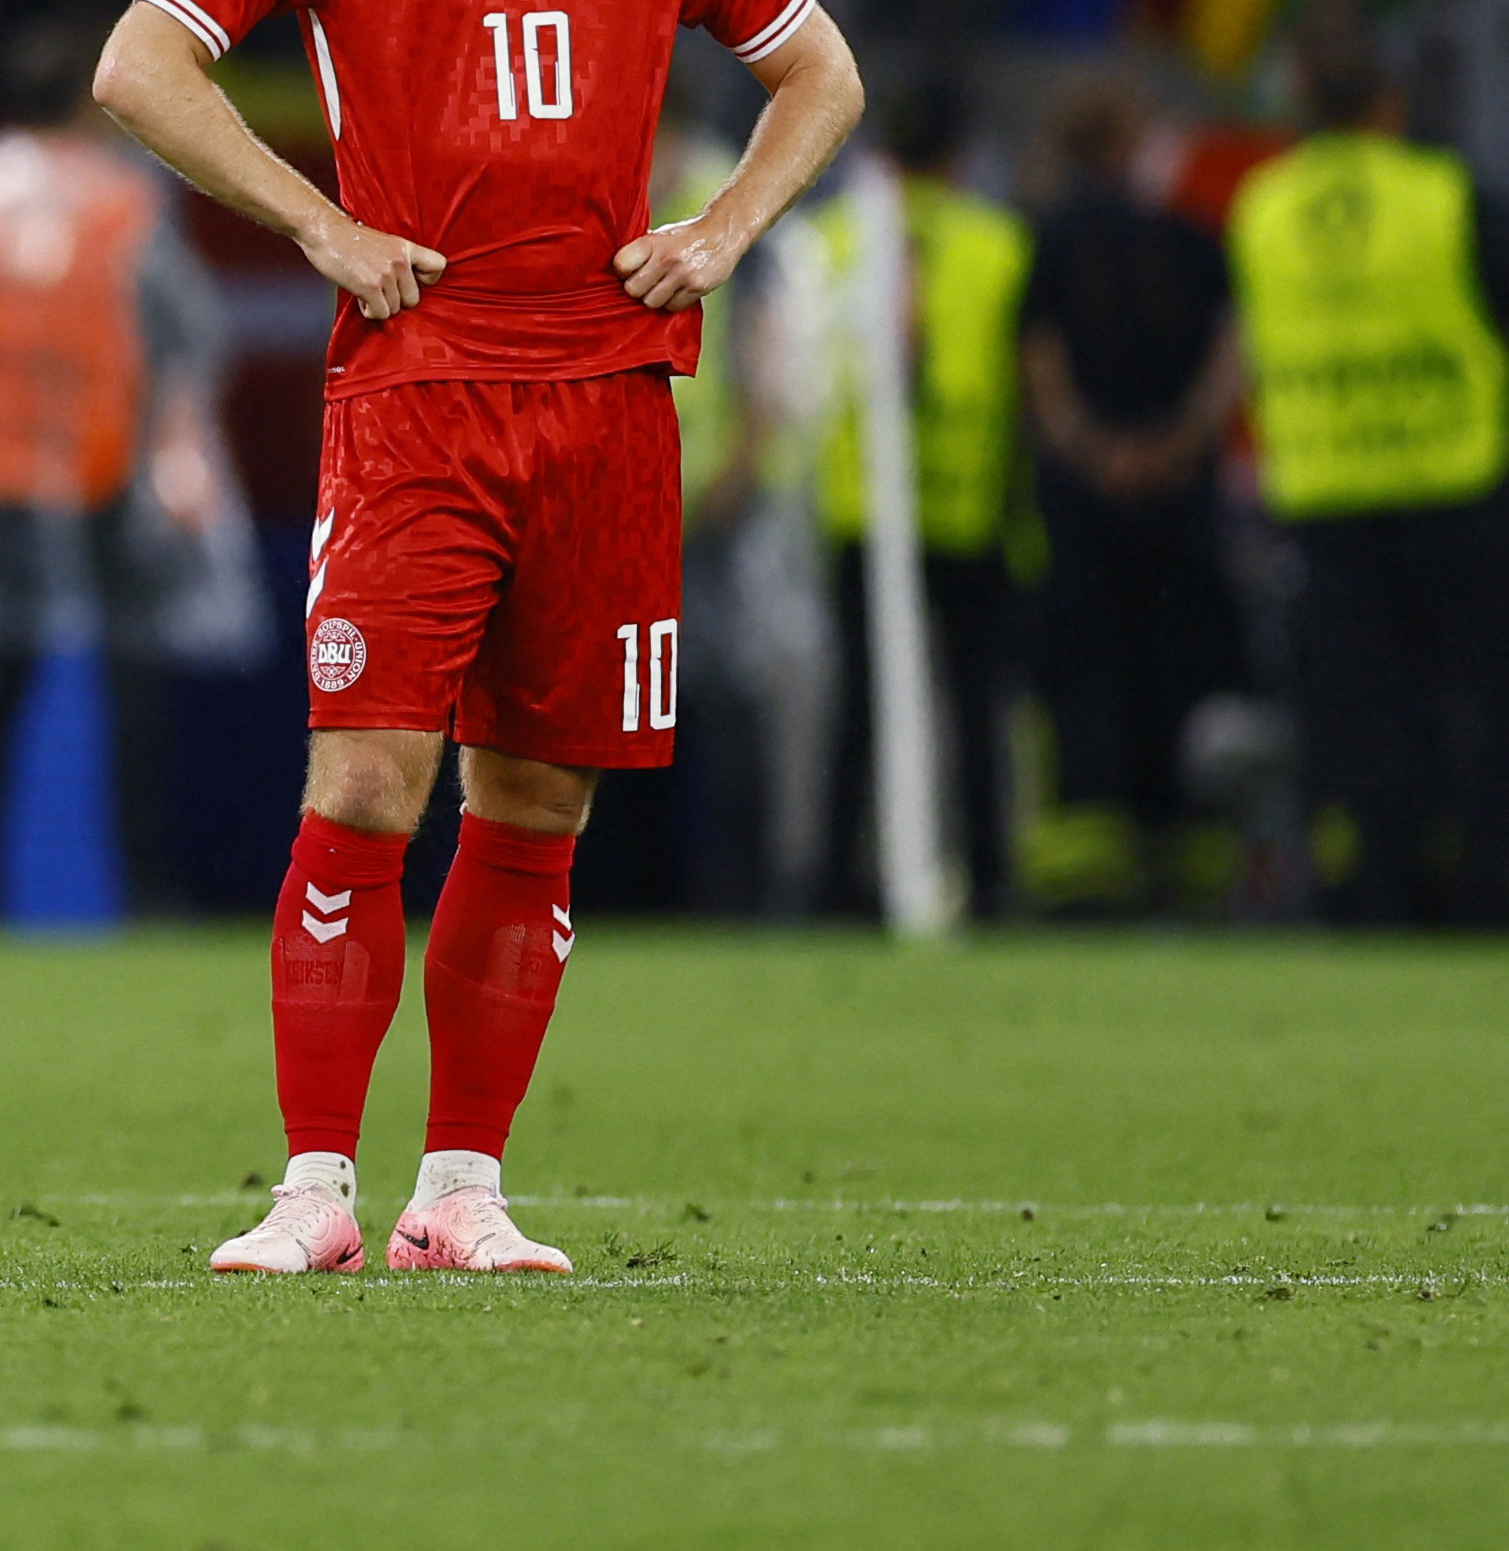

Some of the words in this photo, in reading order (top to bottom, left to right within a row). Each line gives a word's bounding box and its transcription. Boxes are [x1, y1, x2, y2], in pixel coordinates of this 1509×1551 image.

[483, 10, 574, 121] 10
[318, 642, 352, 664] DBU
[346, 641, 364, 680] UNION
[321, 678, 344, 689] 1889
[616, 618, 678, 732] 10
